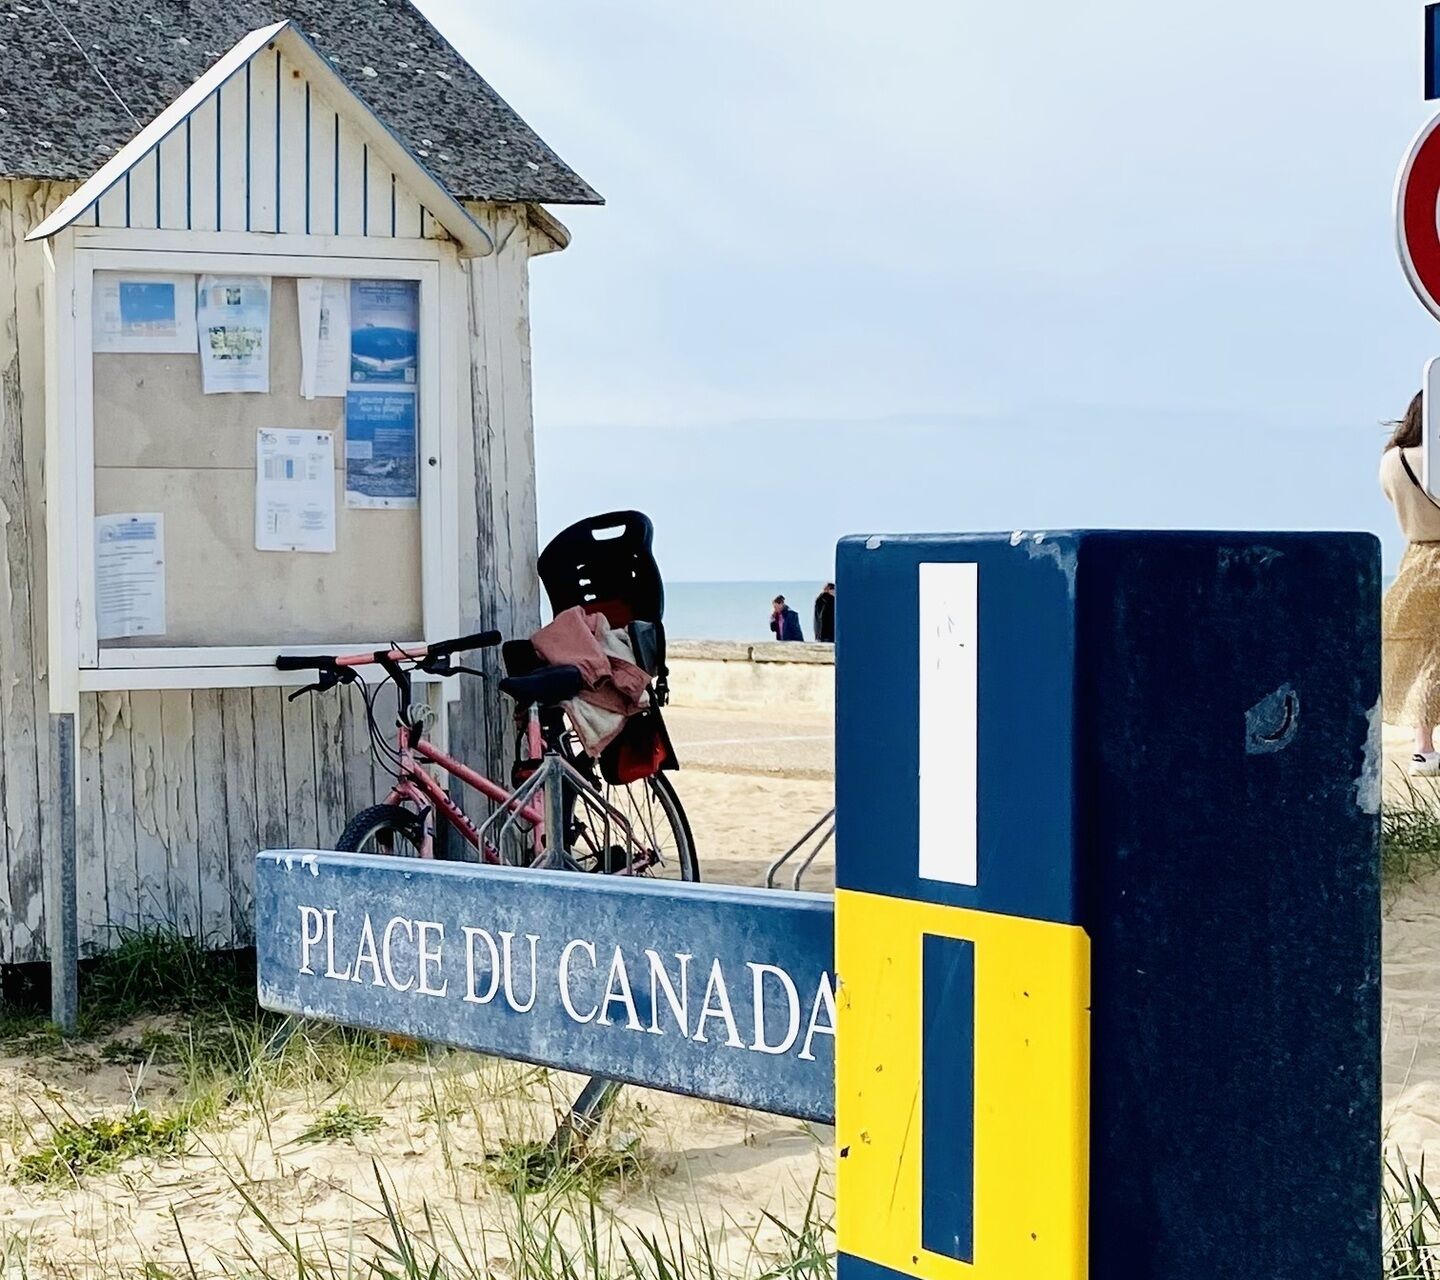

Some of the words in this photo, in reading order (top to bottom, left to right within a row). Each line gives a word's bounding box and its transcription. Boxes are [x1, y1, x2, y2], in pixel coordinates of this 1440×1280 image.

[297, 905, 448, 998] PLACE
[461, 925, 540, 1013] DU
[558, 938, 836, 1061] CANADA
